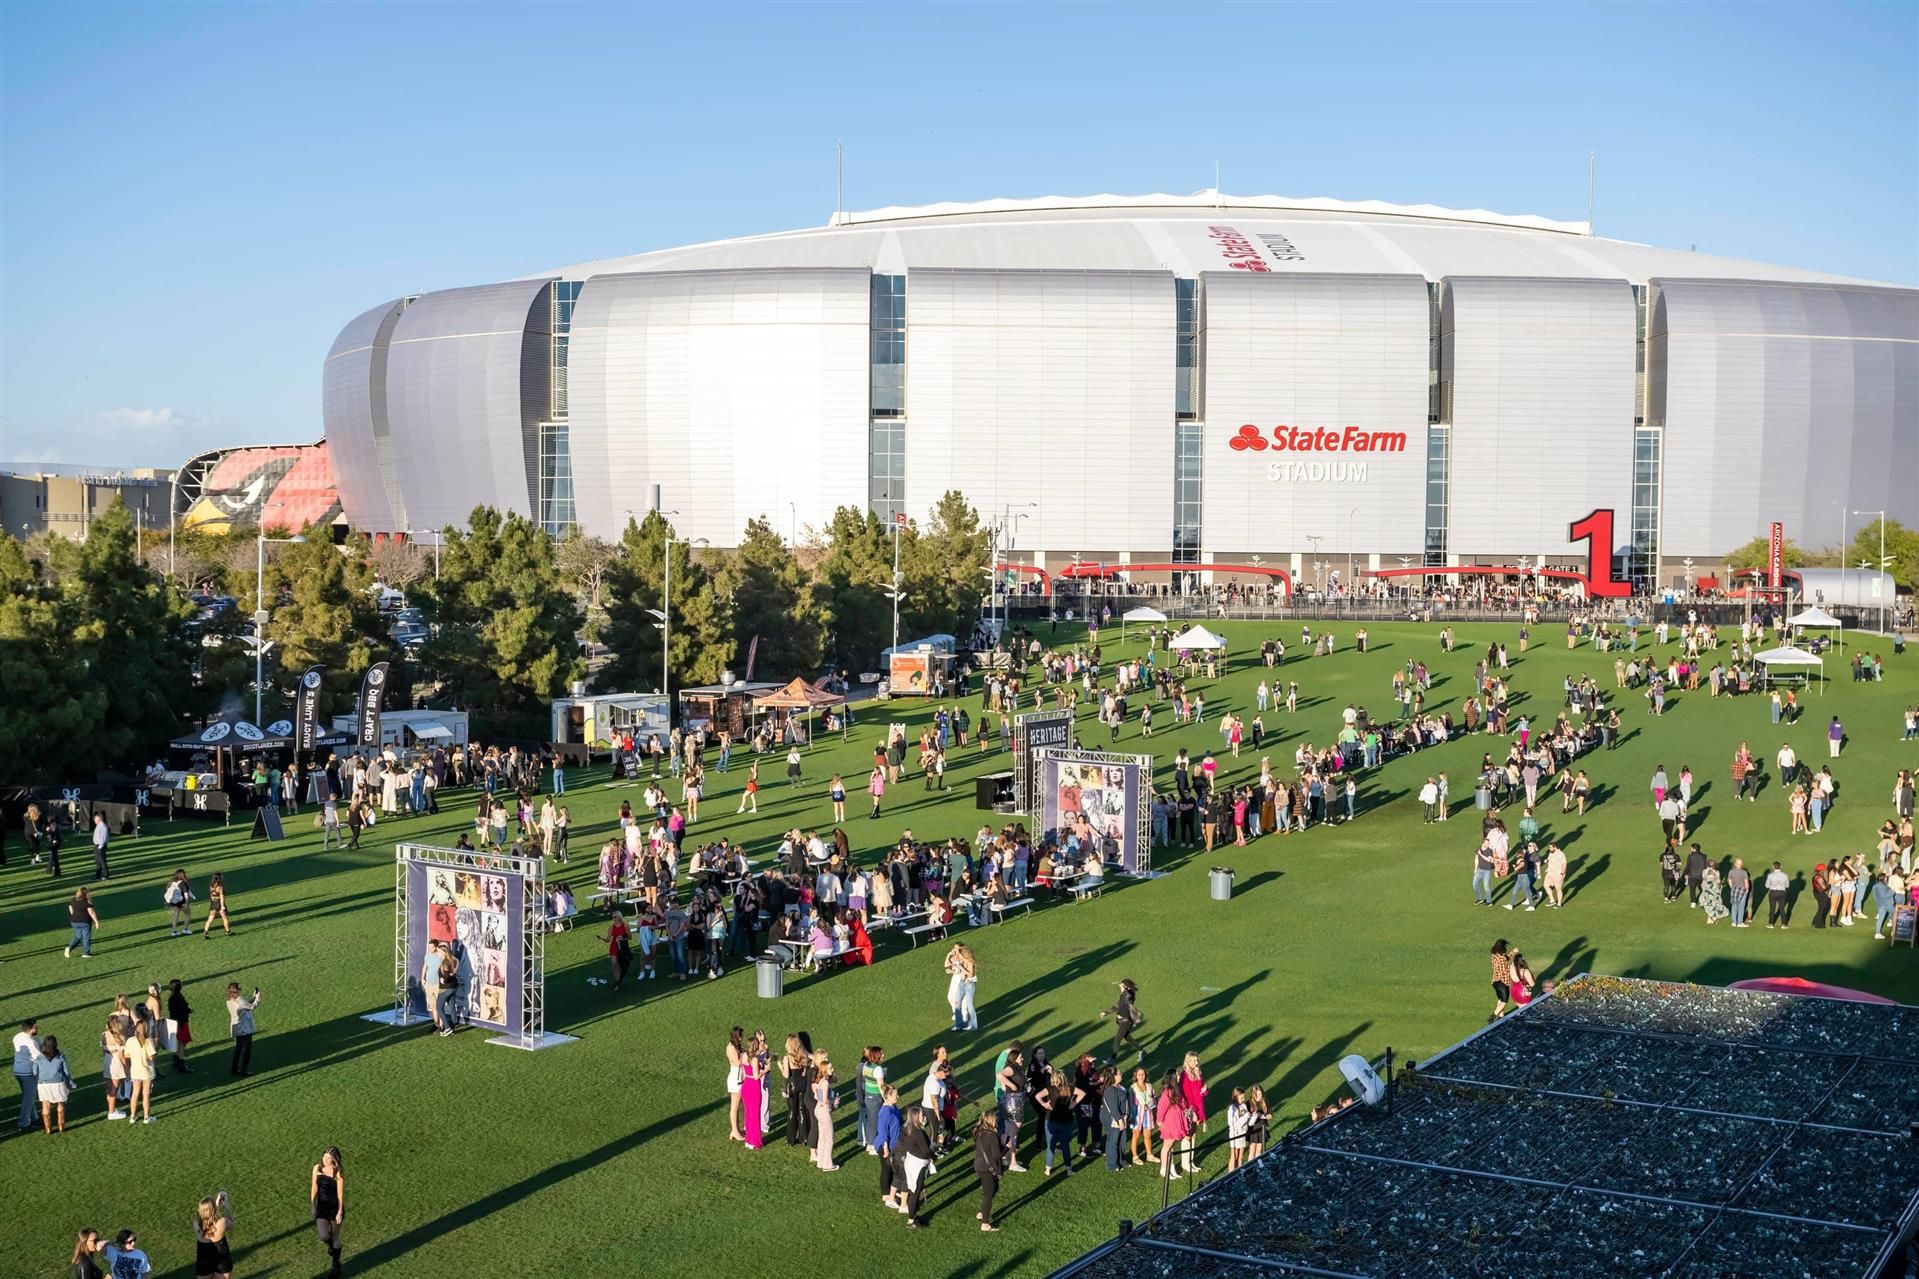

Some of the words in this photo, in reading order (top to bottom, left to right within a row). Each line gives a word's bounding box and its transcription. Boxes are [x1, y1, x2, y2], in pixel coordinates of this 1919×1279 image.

[1267, 461, 1368, 482] STADIUM
[1570, 509, 1632, 597] 1
[1548, 565, 1571, 573] GATE
[305, 690, 315, 721] LUKE'S
[367, 689, 379, 708] BBQ
[303, 723, 312, 749] SAUCY
[364, 710, 375, 742] CRAFT
[1030, 726, 1066, 744] HERITAGE
